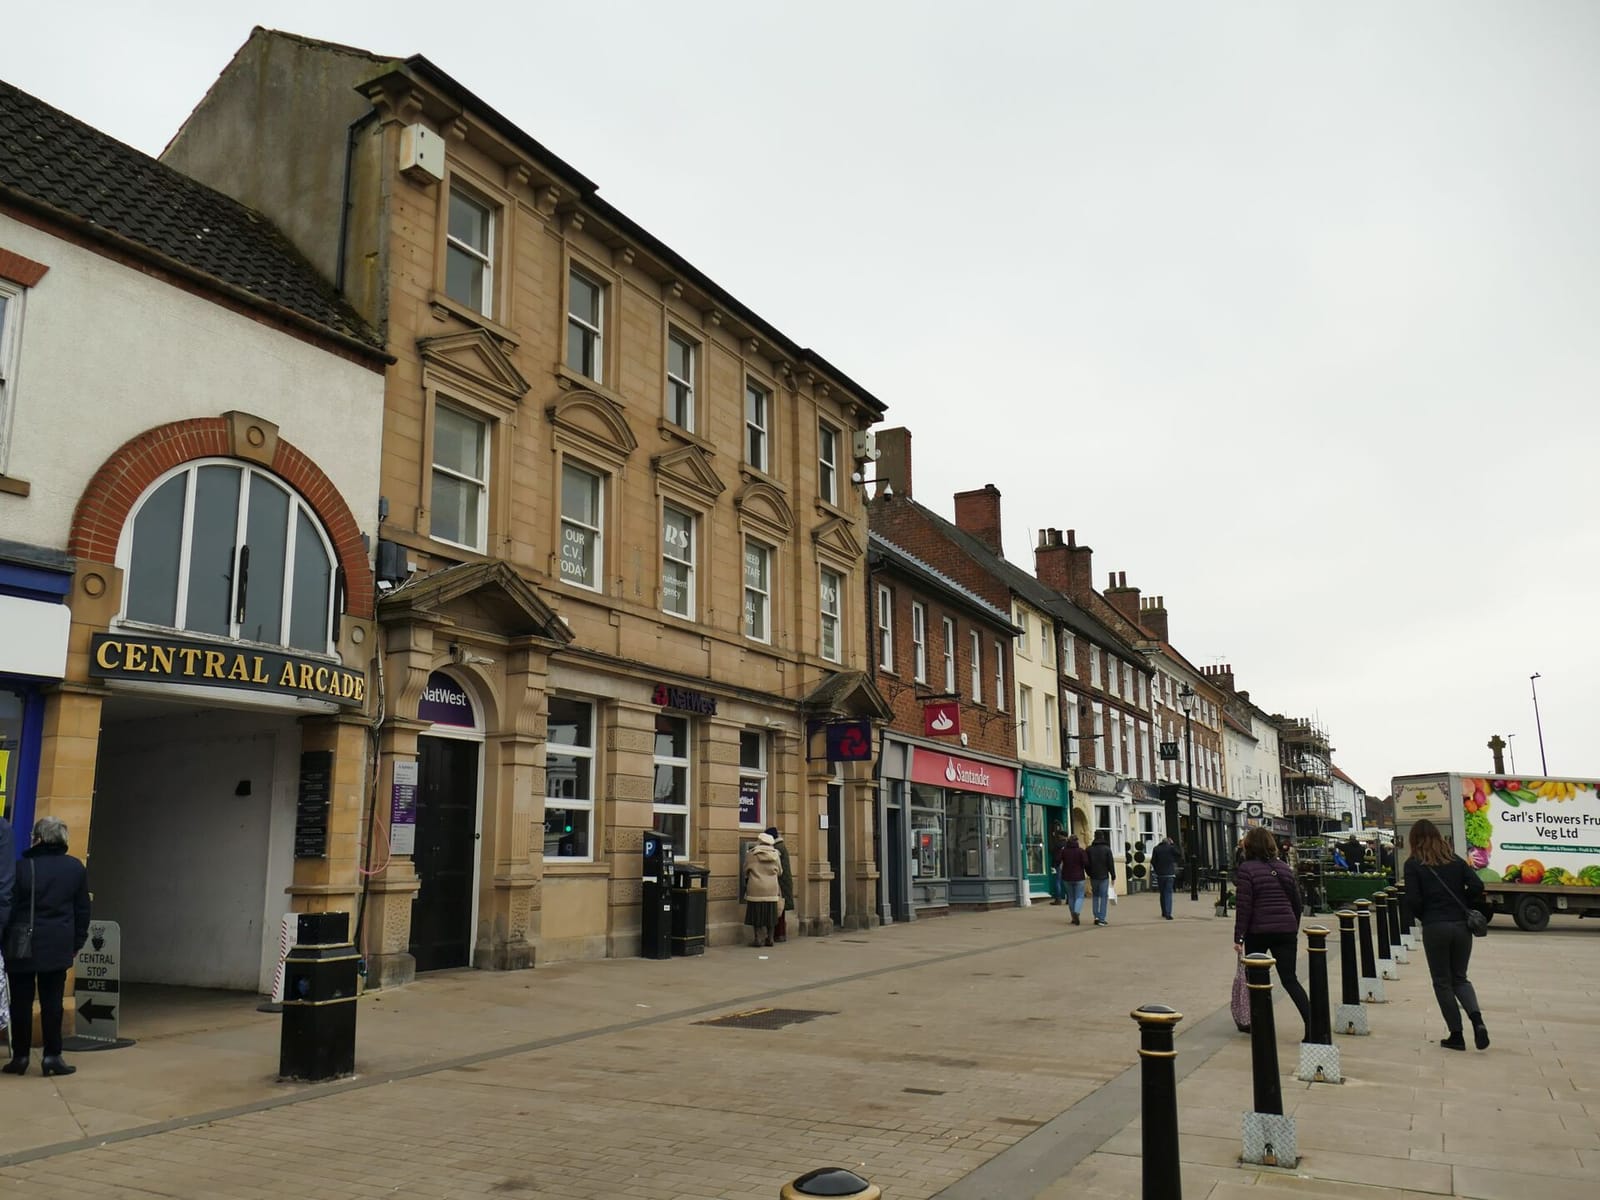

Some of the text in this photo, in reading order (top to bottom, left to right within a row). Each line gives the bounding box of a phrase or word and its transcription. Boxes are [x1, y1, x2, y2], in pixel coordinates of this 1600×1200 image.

[565, 529, 585, 545] OUR
[562, 545, 582, 560] C.V.
[560, 559, 587, 578] ODAY
[96, 640, 365, 701] CENTRAL ARCADE
[420, 686, 467, 707] NatWest
[669, 687, 717, 715] NatWest
[1162, 744, 1176, 755] W
[956, 763, 990, 787] Santander
[1501, 811, 1533, 823] Carl's
[1536, 812, 1581, 825] Flowers
[1536, 826, 1578, 840] Veg Ltd
[645, 841, 653, 855] P
[79, 953, 115, 965] CENTRAL
[87, 966, 108, 977] STOP
[87, 980, 106, 991] CAFE
